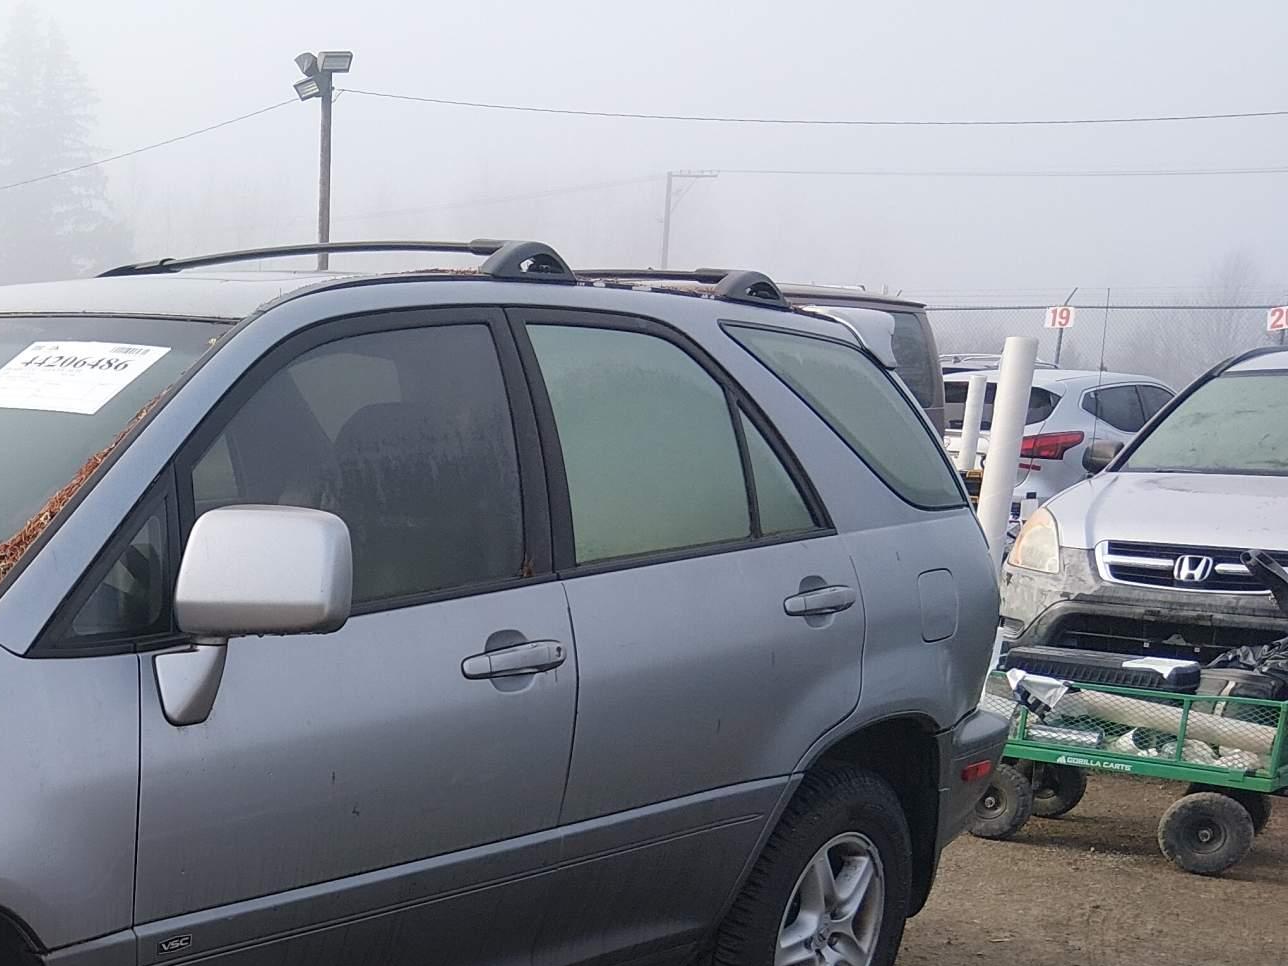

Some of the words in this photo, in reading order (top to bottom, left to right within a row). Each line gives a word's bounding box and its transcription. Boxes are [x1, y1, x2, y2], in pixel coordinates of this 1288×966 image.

[1051, 308, 1070, 326] 19
[1271, 308, 1288, 329] 2
[22, 355, 132, 371] 44206486
[1067, 757, 1101, 767] GORILLA
[1103, 761, 1132, 771] CARTS
[162, 937, 189, 951] VSC
